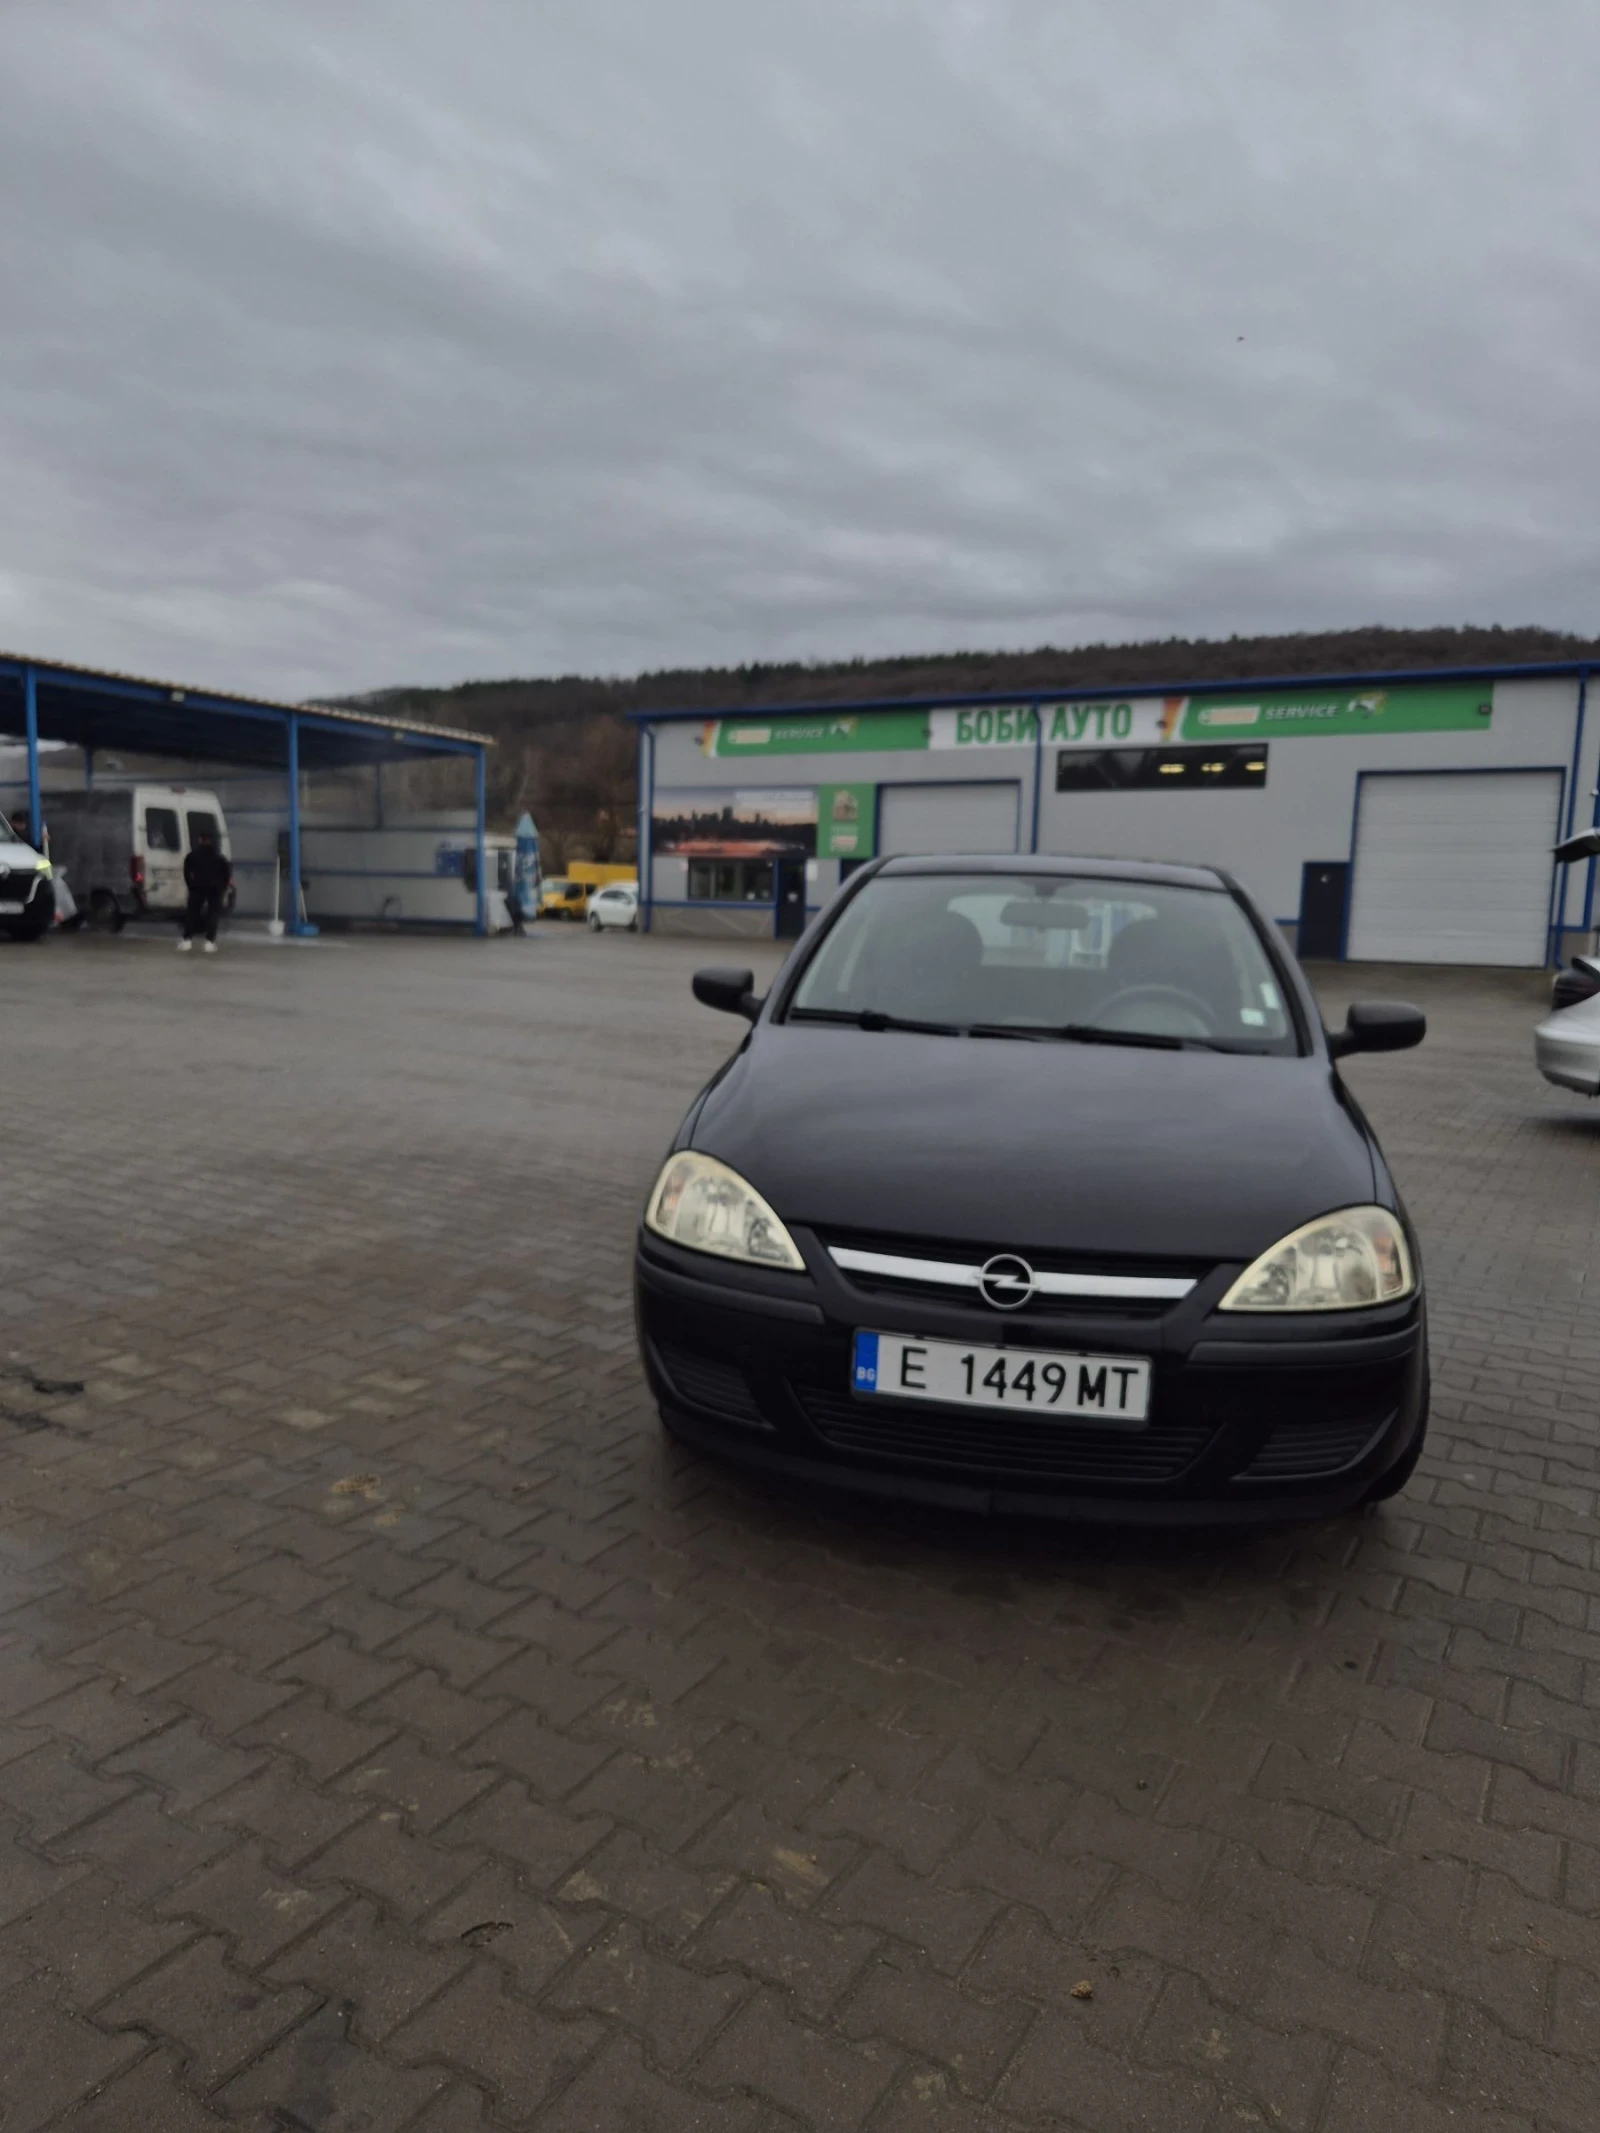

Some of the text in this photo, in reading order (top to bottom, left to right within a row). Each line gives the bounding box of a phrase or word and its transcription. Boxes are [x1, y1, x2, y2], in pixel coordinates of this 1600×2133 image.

[957, 704, 1132, 745] БОБИ АУТО
[1265, 704, 1339, 719] SERVICE
[856, 1367, 876, 1382] BG
[900, 1345, 1139, 1409] E 1449 MT
